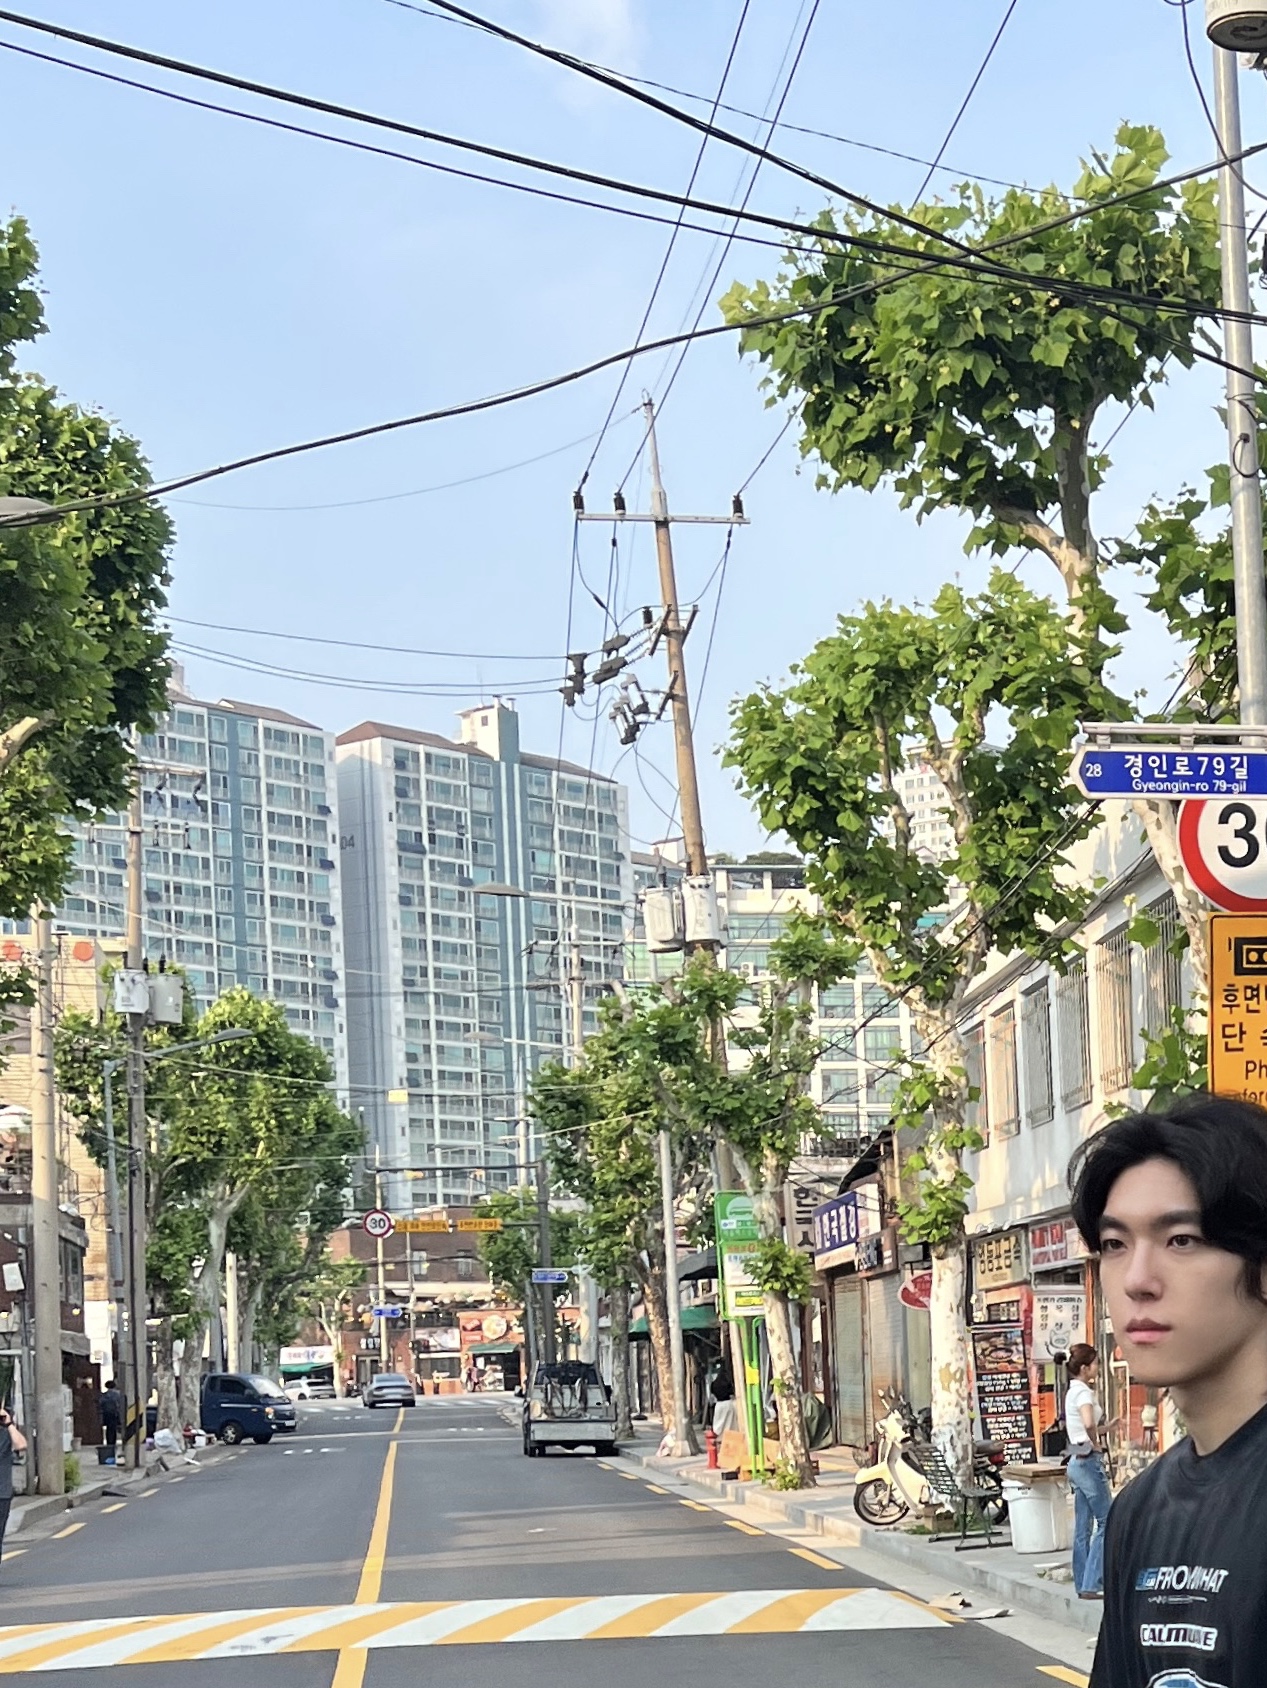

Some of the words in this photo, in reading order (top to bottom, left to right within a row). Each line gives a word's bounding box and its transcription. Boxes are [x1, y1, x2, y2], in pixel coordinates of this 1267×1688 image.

[1086, 763, 1102, 778] 28
[1124, 754, 1249, 780] 경인로79길
[1132, 779, 1209, 794] Gyeongin-ro
[1213, 780, 1247, 794] 79-gil
[369, 1218, 386, 1229] 30
